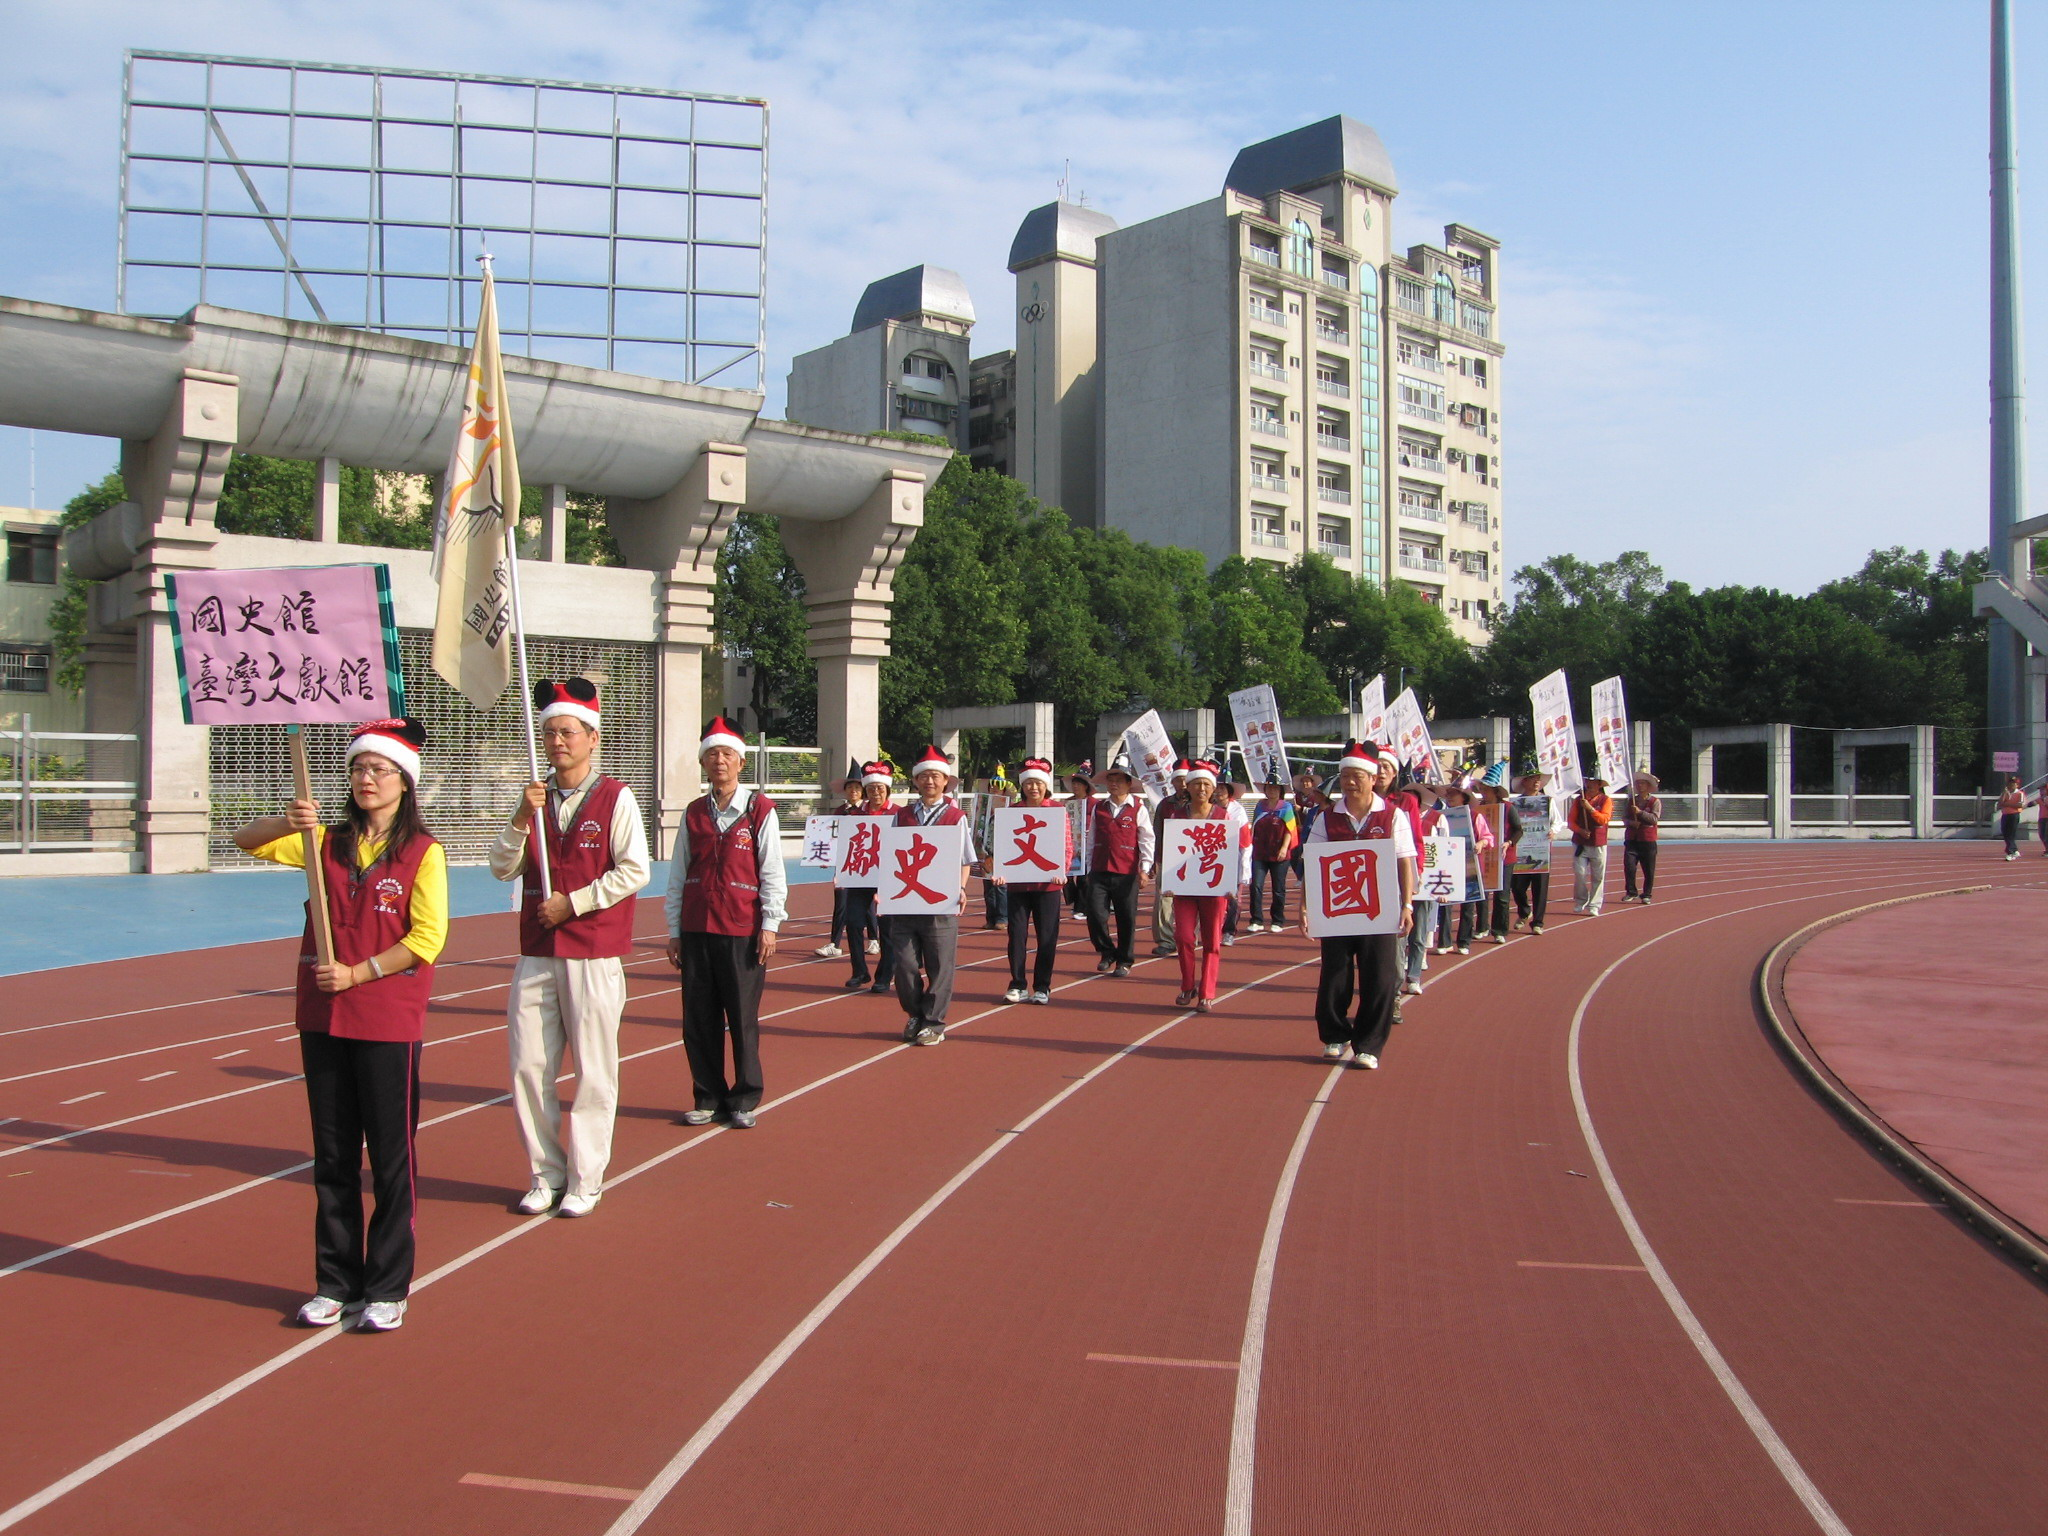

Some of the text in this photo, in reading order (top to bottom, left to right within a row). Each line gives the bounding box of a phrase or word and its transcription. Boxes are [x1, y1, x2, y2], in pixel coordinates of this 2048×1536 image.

[190, 590, 320, 637] 國史館
[192, 651, 375, 707] 臺灣文獻館
[810, 841, 831, 862] 走
[890, 832, 949, 905] 史
[1003, 814, 1060, 872] 文
[1177, 822, 1228, 889] 灣
[1319, 848, 1381, 921] 國
[1427, 870, 1454, 896] 去
